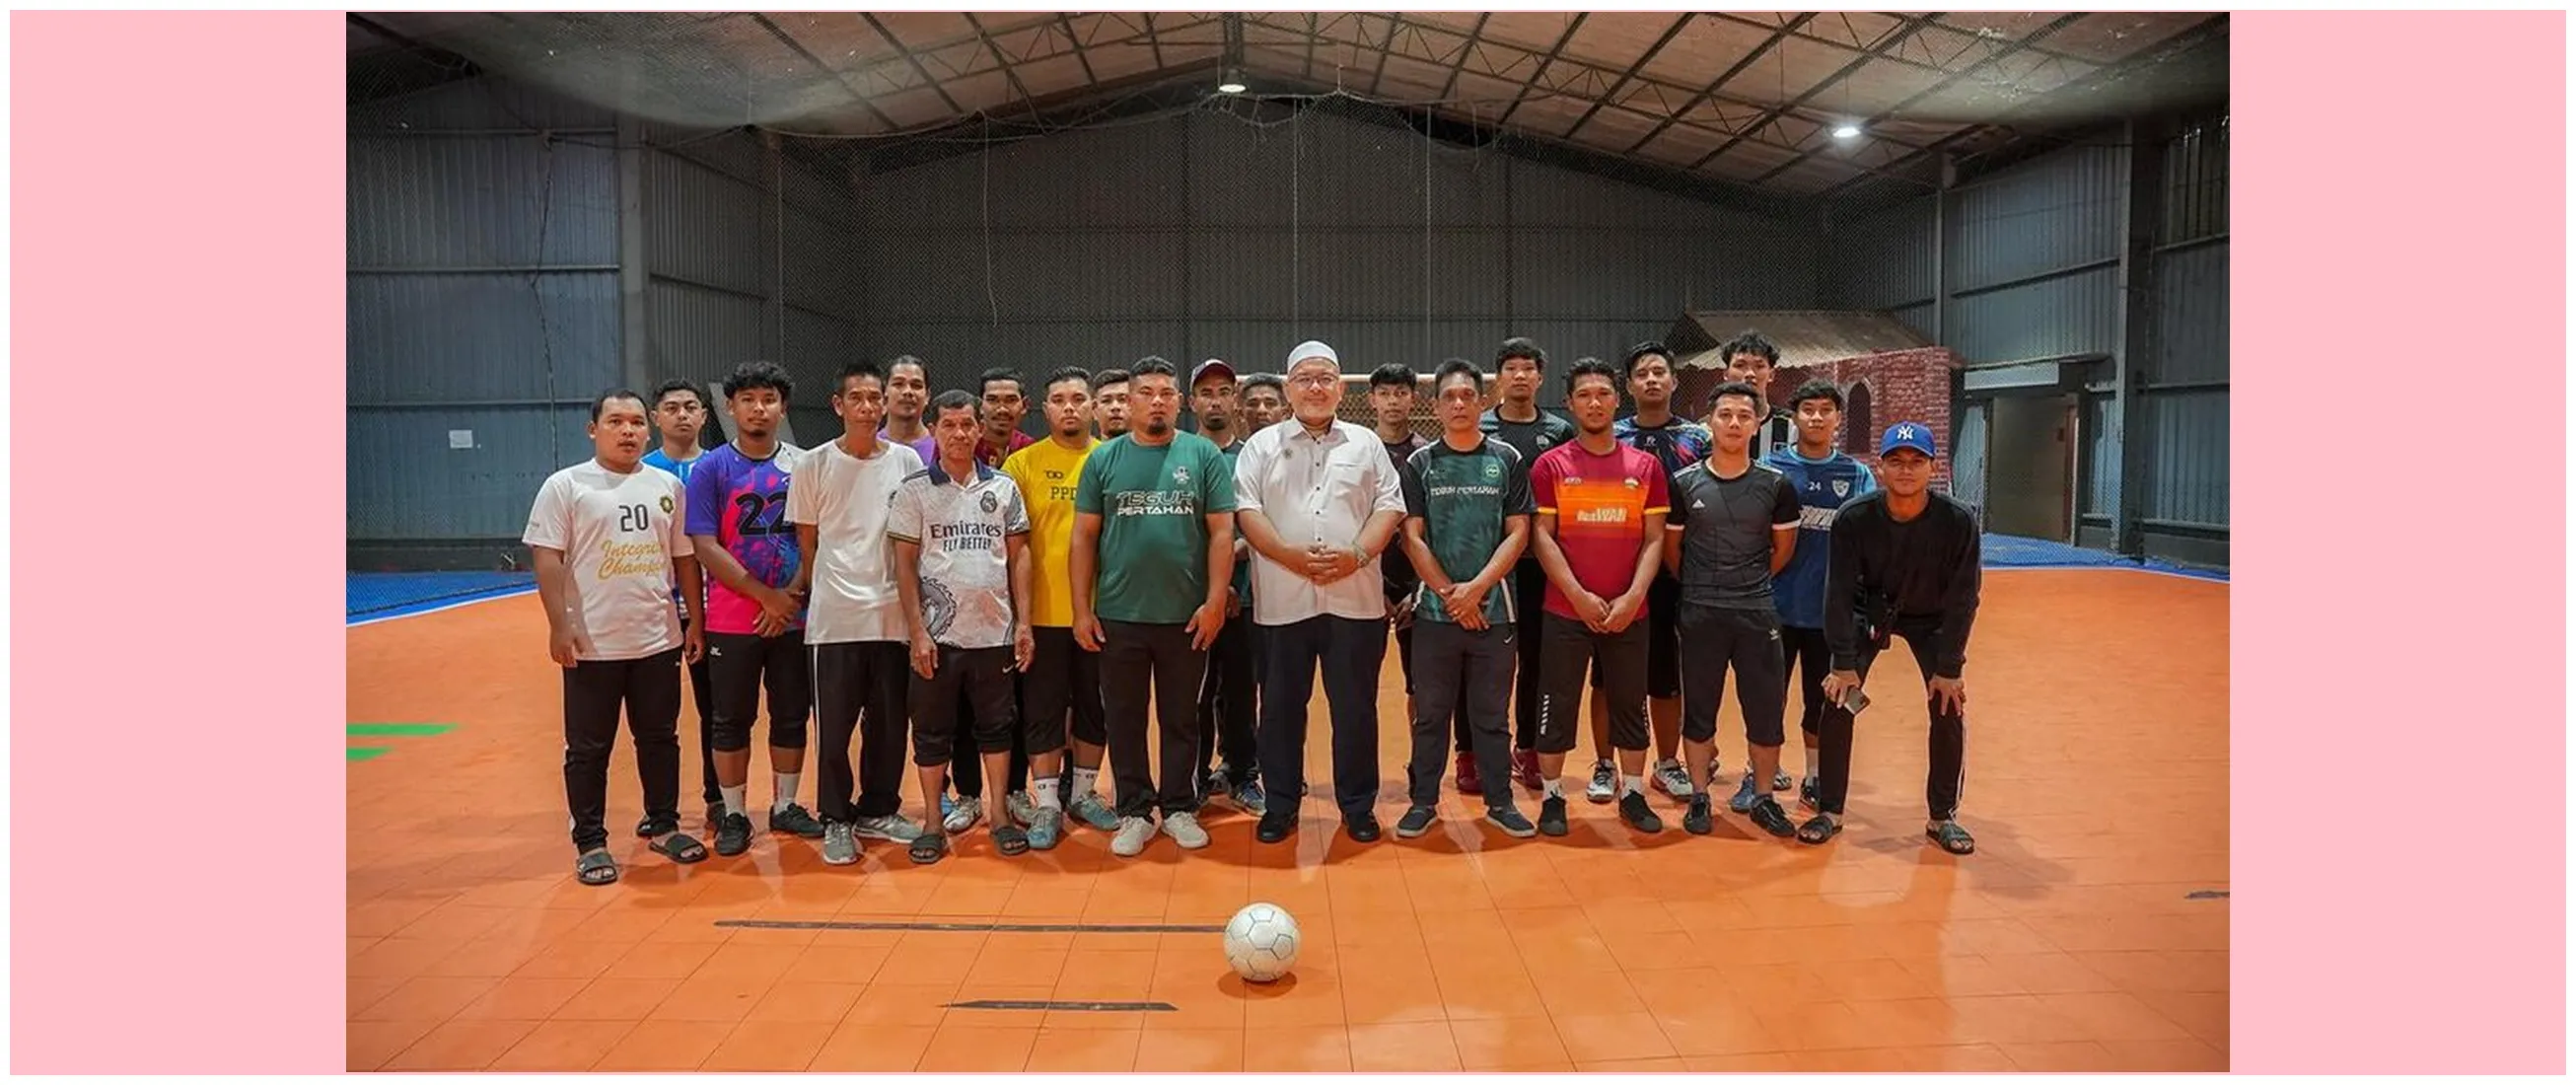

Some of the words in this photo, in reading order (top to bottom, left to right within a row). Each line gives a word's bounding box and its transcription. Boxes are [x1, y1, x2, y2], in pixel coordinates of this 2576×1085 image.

[1896, 425, 1914, 440] NY
[1808, 481, 1822, 491] 24
[1115, 489, 1196, 507] TEGUH
[618, 503, 649, 533] 20
[735, 490, 788, 536] 22
[1116, 506, 1195, 517] PERTAHAN
[930, 521, 1002, 539] Emirates
